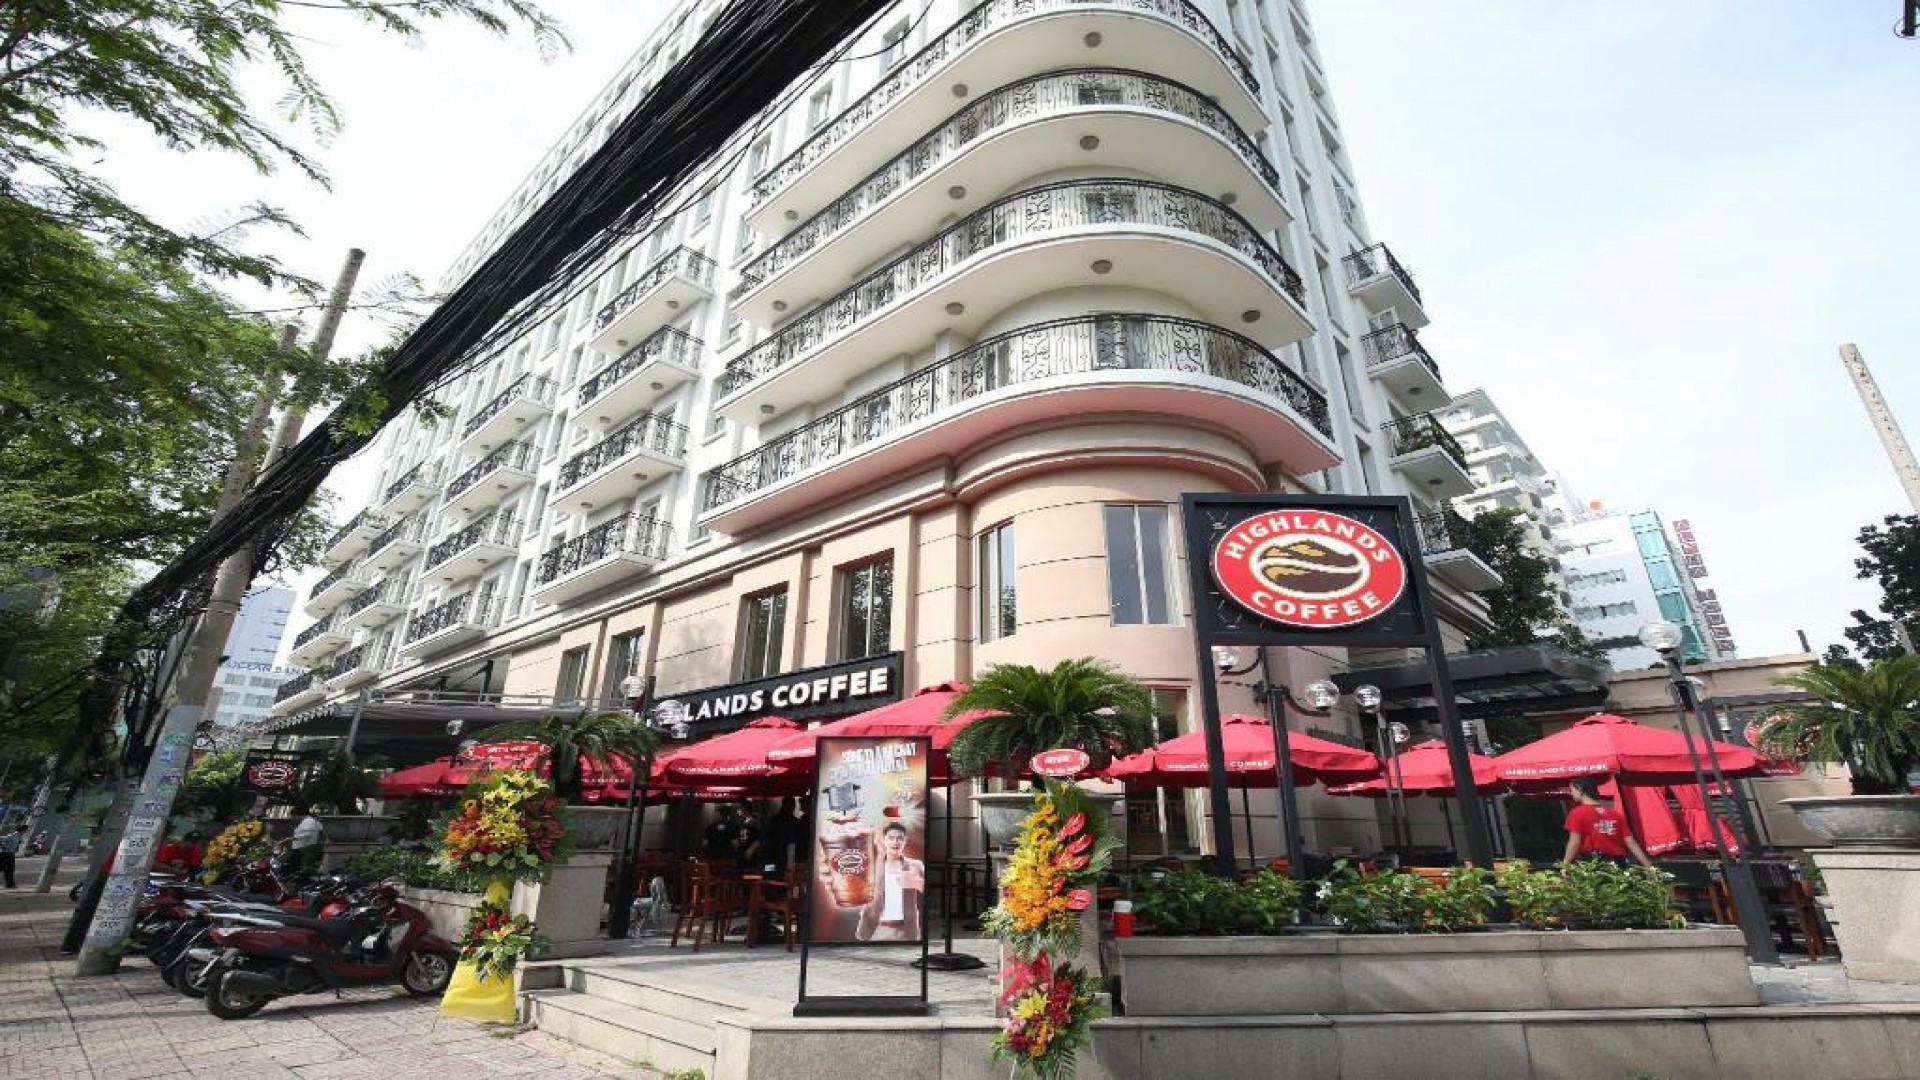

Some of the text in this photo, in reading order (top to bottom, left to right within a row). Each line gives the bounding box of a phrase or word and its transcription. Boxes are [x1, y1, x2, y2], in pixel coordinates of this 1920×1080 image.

[1225, 515, 1391, 563] HIGHLANDS
[1252, 591, 1382, 620] COFFEE
[772, 666, 887, 706] COFFEE
